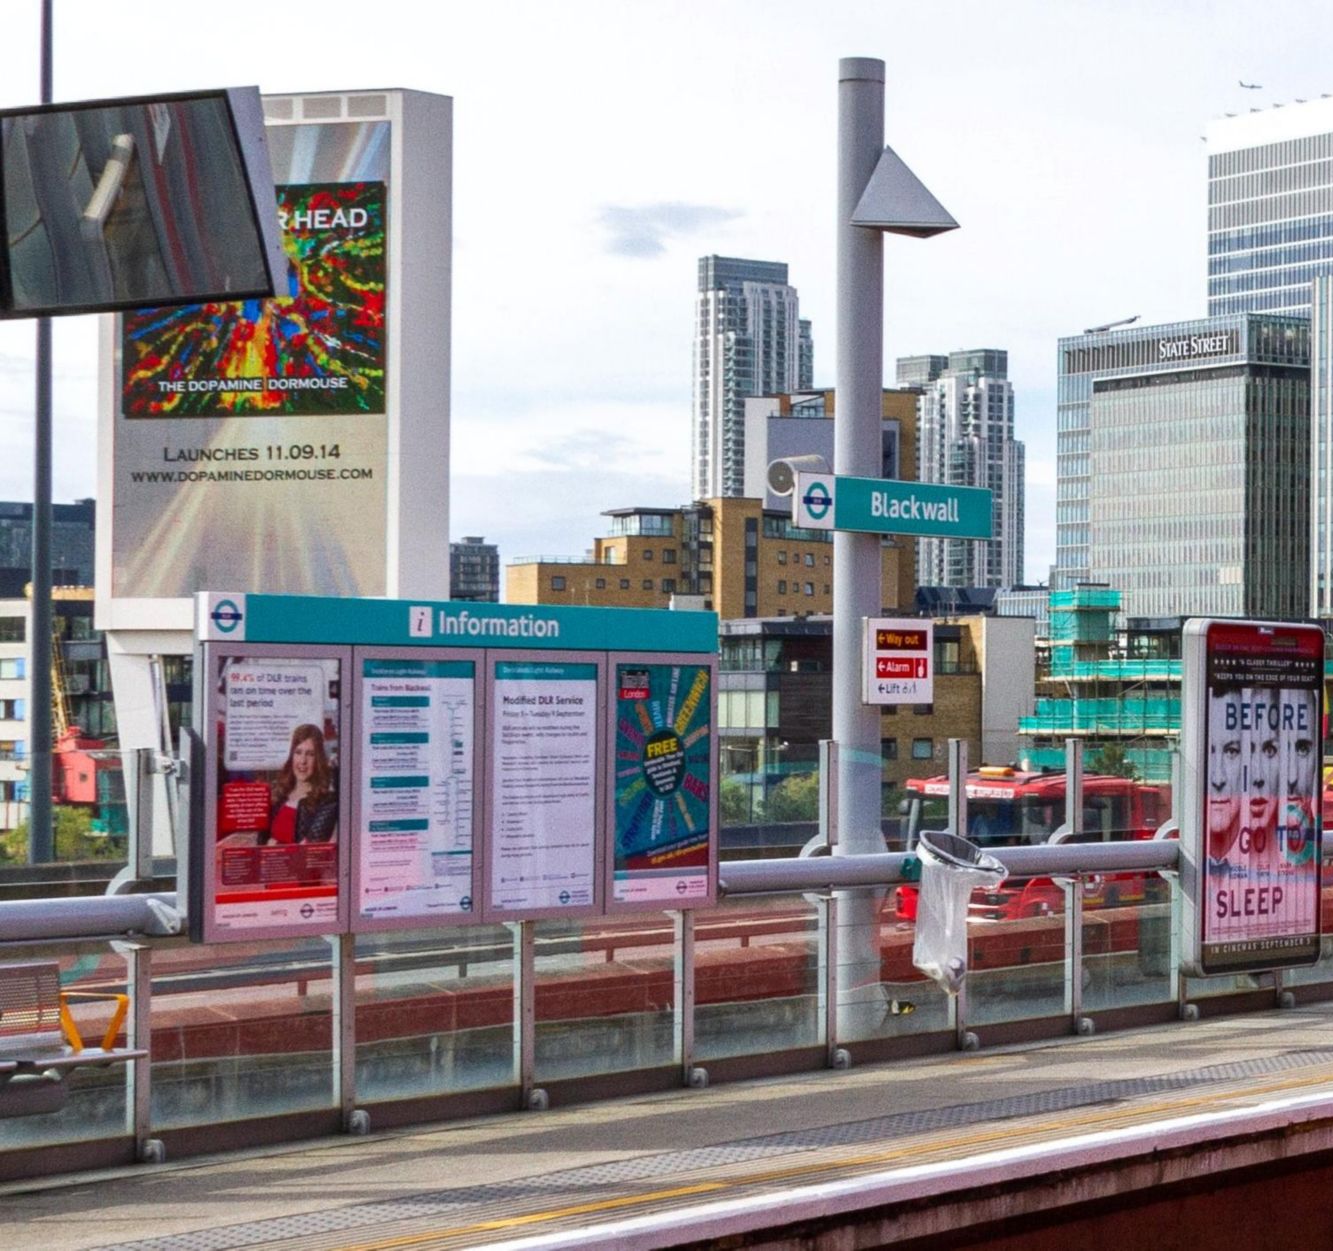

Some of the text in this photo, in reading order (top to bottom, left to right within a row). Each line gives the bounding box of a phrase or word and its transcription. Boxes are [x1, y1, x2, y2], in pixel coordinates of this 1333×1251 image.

[295, 207, 368, 230] HEAD
[1159, 335, 1229, 359] STATE STREET
[158, 377, 348, 393] THE DOPAMINE DORMOUSE
[266, 444, 341, 461] 11.09.14
[131, 468, 373, 483] WWW.DOPAMINEDORMOUSE.COM
[871, 491, 960, 523] Blackwall
[438, 610, 560, 637] Information
[885, 632, 919, 647] Way out
[886, 661, 911, 673] Alarm
[886, 682, 900, 694] Lift
[538, 695, 554, 705] DLR
[555, 695, 584, 705] Service
[1225, 702, 1308, 731] BEFORE
[646, 737, 678, 758] FREE
[1243, 765, 1248, 792] I
[1239, 826, 1266, 854] GO
[1216, 886, 1283, 919] SLEEP
